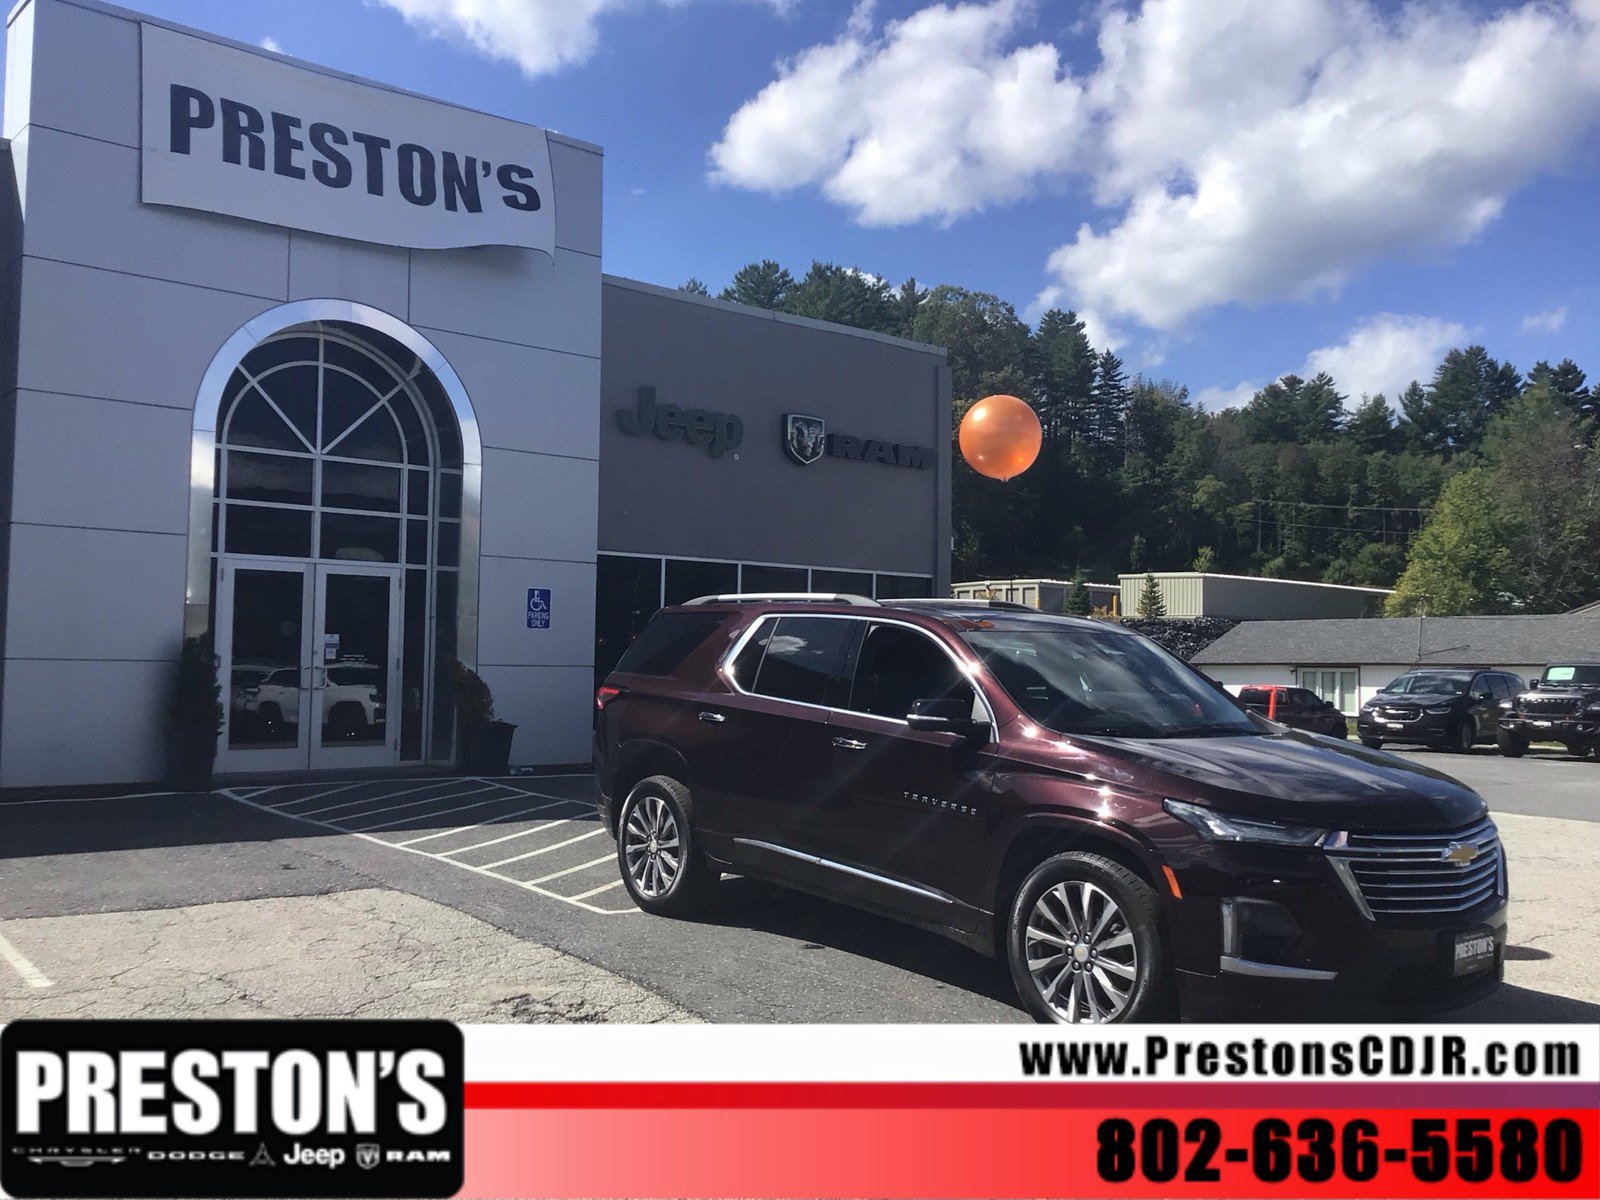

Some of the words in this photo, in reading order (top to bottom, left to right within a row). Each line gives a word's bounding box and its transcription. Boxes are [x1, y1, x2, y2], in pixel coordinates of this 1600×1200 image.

[170, 83, 541, 213] PRESTON'S
[616, 385, 744, 459] Jeep
[826, 433, 936, 469] RAM
[903, 791, 977, 815] TRAVERSE
